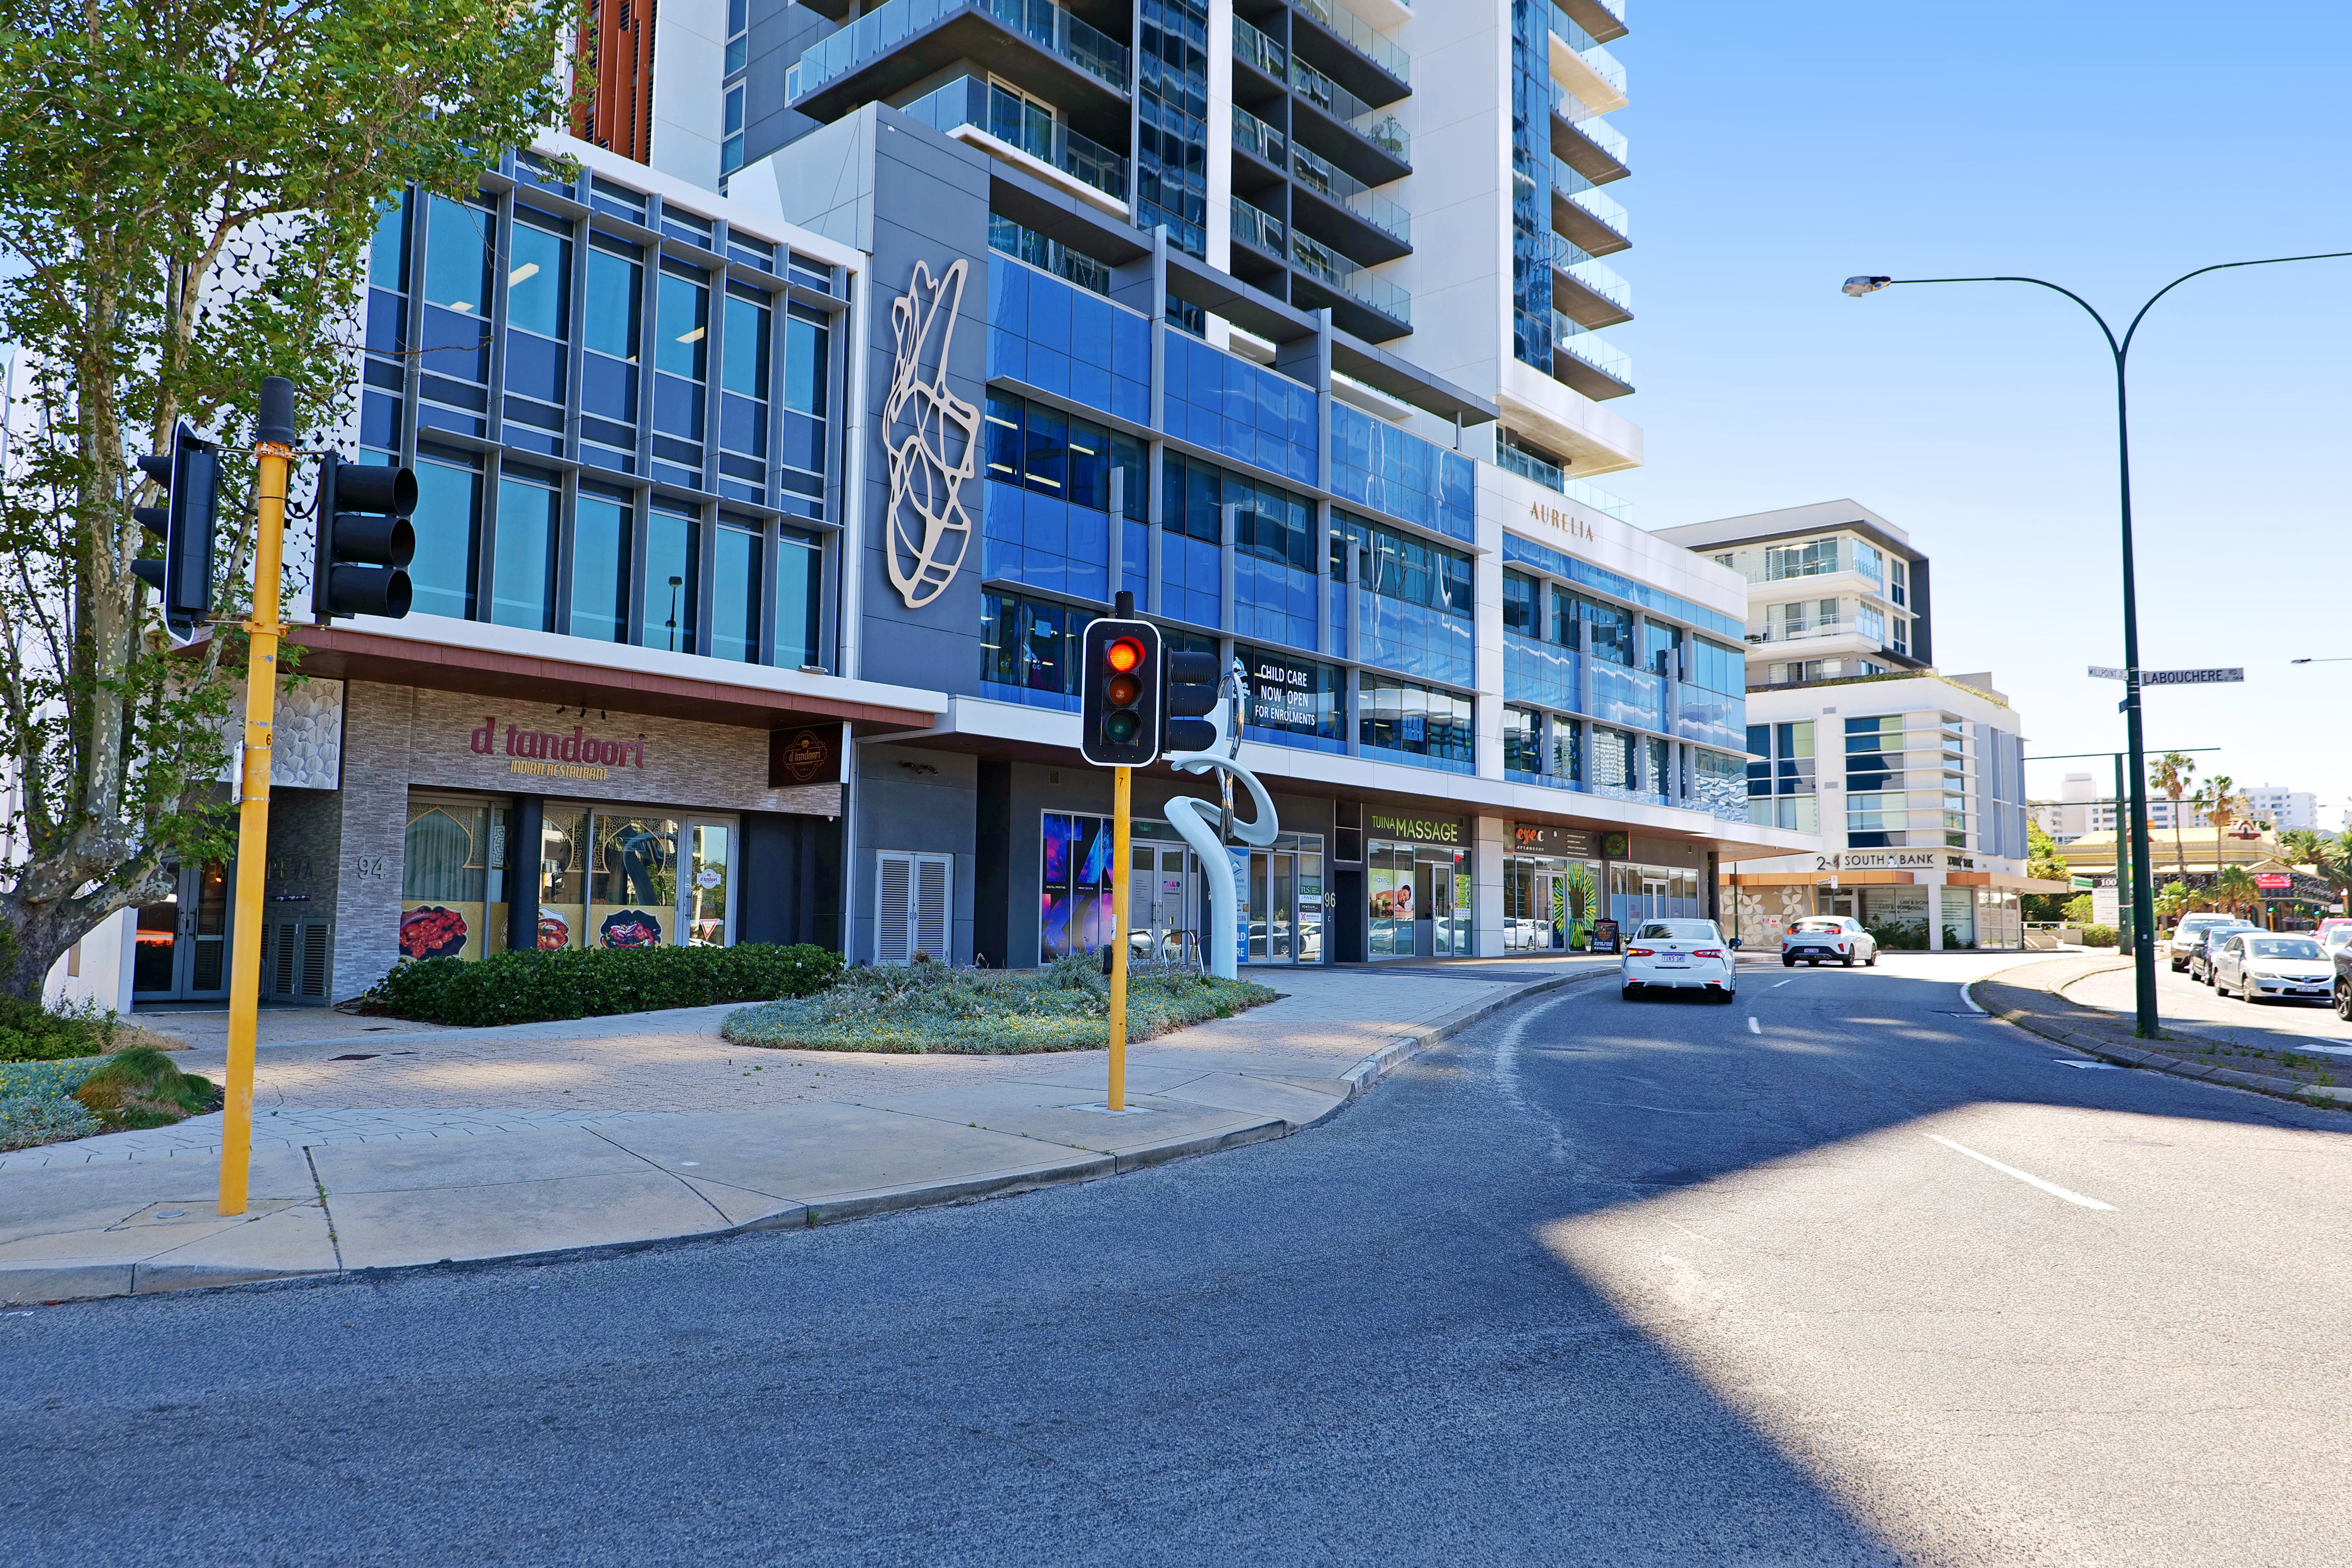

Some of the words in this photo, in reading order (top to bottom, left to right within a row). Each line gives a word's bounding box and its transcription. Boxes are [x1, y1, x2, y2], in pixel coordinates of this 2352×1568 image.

[1530, 501, 1594, 542] AURELIA
[1261, 664, 1285, 682] CHILD
[1287, 670, 1307, 687] CARE
[2144, 670, 2223, 684] LABOUCHERE
[1261, 685, 1282, 702] NOW
[1287, 690, 1308, 707] OPEN
[1255, 705, 1269, 718] FOR
[1270, 707, 1315, 726] ENROLMENTS
[267, 734, 271, 746] 6
[471, 717, 495, 755] d
[506, 724, 643, 768] tandoori
[789, 751, 793, 762] d
[795, 748, 820, 761] tandoori
[510, 760, 544, 776] INDIAN
[546, 764, 608, 781] RESTAURANT
[1119, 777, 1123, 786] 7
[1372, 815, 1396, 830] TUINA
[1396, 818, 1458, 842] MASSAGE
[358, 855, 387, 879] 94
[1844, 855, 1884, 866] SOUTH
[1900, 854, 1934, 864] BANK
[1373, 875, 1390, 886] Waxing
[1325, 892, 1336, 908] 96
